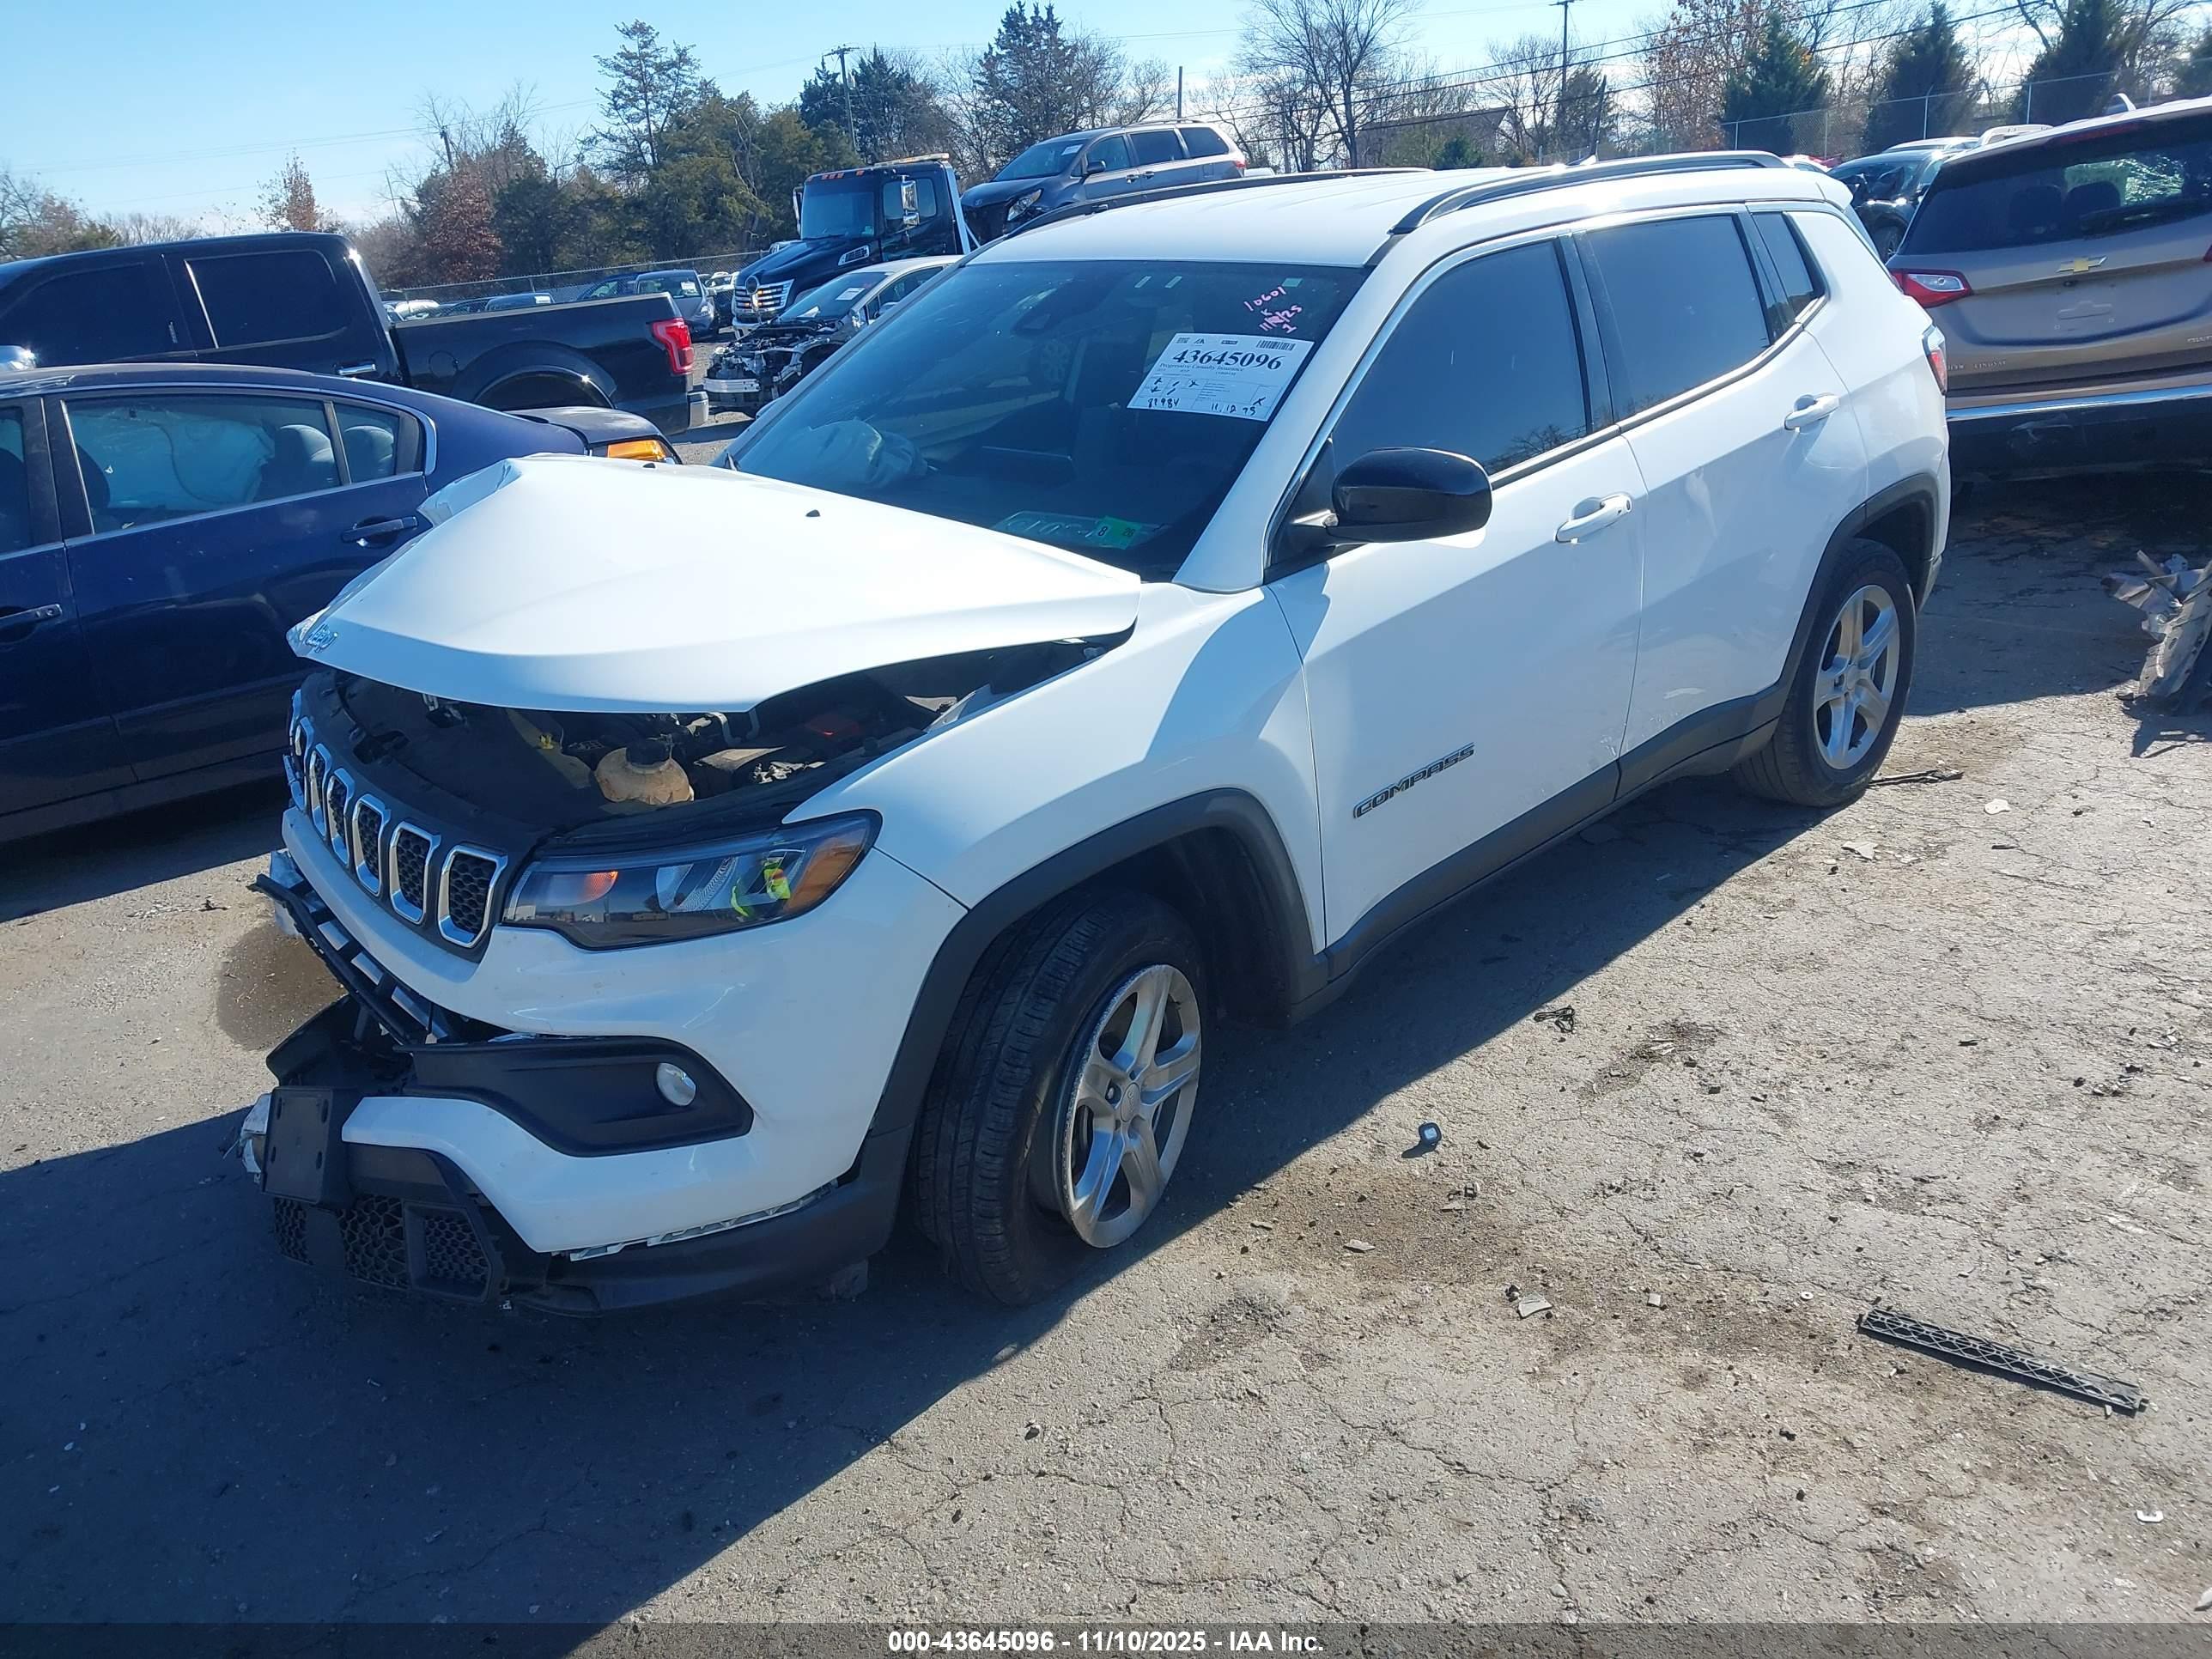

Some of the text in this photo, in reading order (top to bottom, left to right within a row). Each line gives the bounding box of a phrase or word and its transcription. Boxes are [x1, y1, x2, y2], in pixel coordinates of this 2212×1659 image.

[1172, 349, 1286, 370] 43645096
[1098, 526, 1109, 537] 8
[1353, 742, 1475, 818] COMPASS
